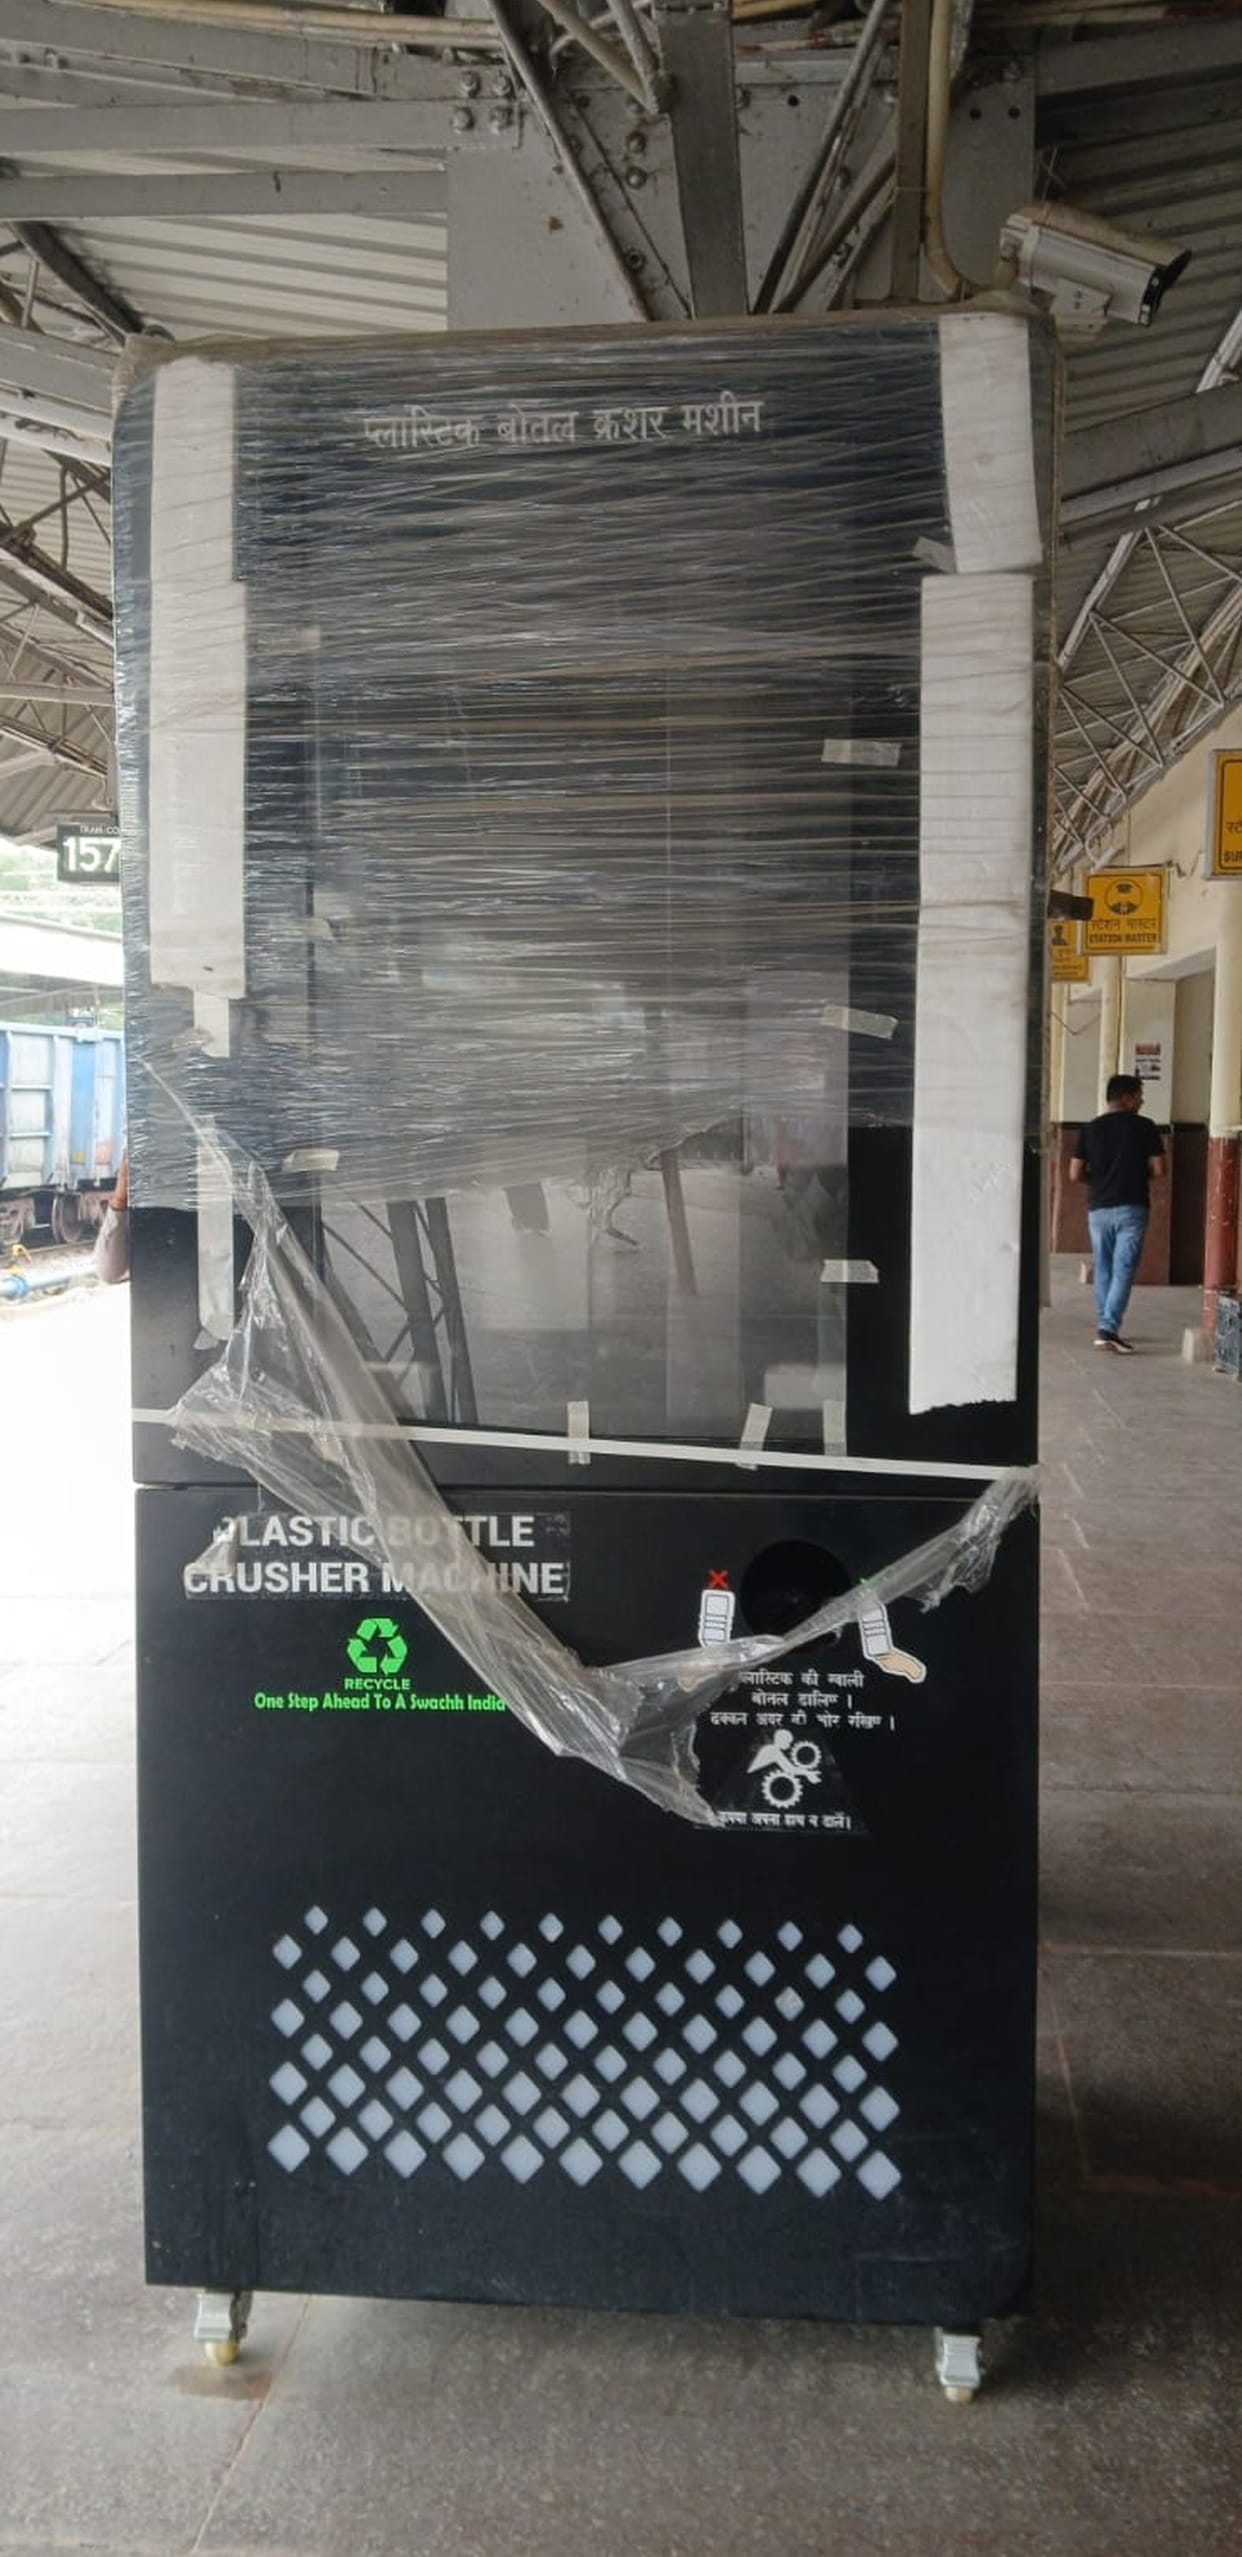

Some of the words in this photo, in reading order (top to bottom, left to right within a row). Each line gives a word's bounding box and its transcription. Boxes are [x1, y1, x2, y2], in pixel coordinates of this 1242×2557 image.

[497, 403, 579, 446] बोतल
[593, 405, 672, 441] क्रशर
[681, 391, 765, 434] मशीन
[184, 1562, 368, 1593] CRUSHER
[344, 1678, 410, 1690] RECYCLE
[254, 1692, 284, 1709] One
[288, 1692, 319, 1711] Step
[322, 1692, 370, 1710] Ahead
[373, 1693, 391, 1710] To
[394, 1693, 406, 1710] A
[410, 1693, 464, 1711] Swachh
[468, 1694, 506, 1711] India
